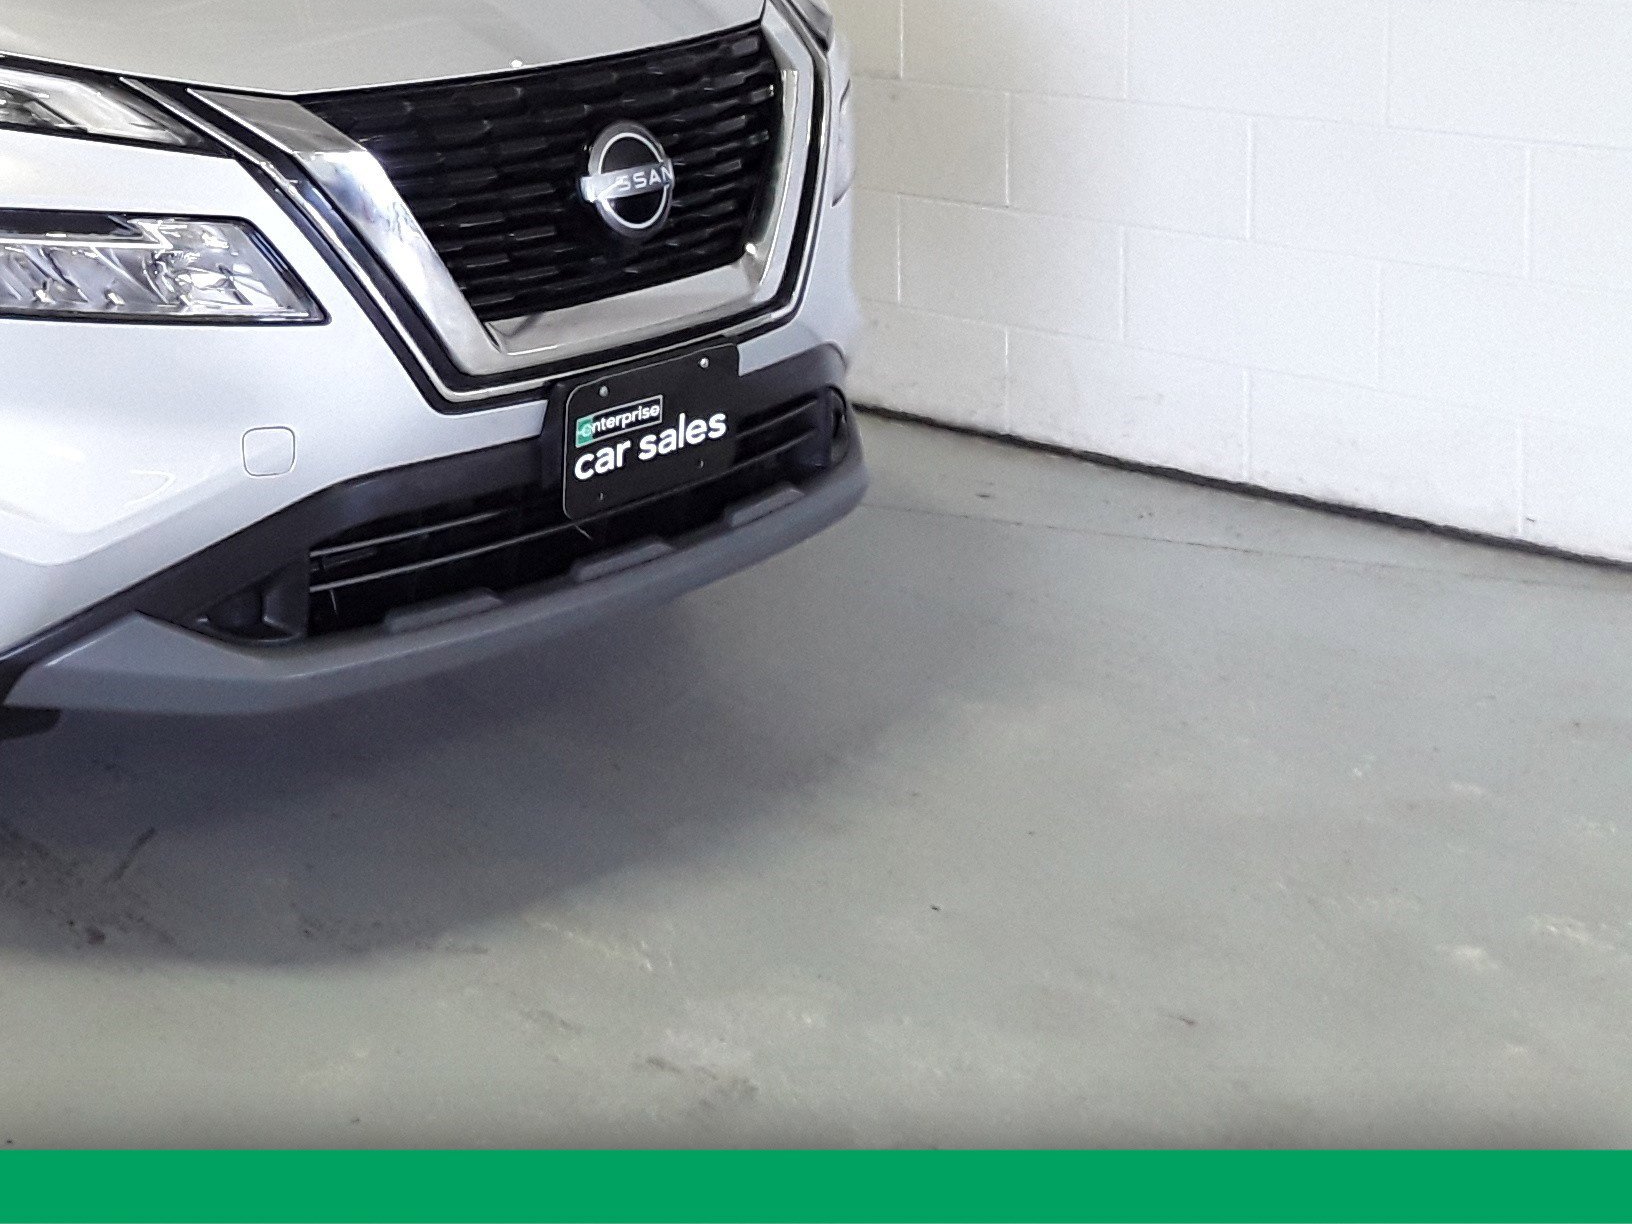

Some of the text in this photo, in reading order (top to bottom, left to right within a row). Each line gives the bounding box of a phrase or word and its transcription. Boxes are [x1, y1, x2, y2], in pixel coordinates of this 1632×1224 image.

[574, 412, 726, 480] car sales
[578, 404, 660, 438] enterprise
